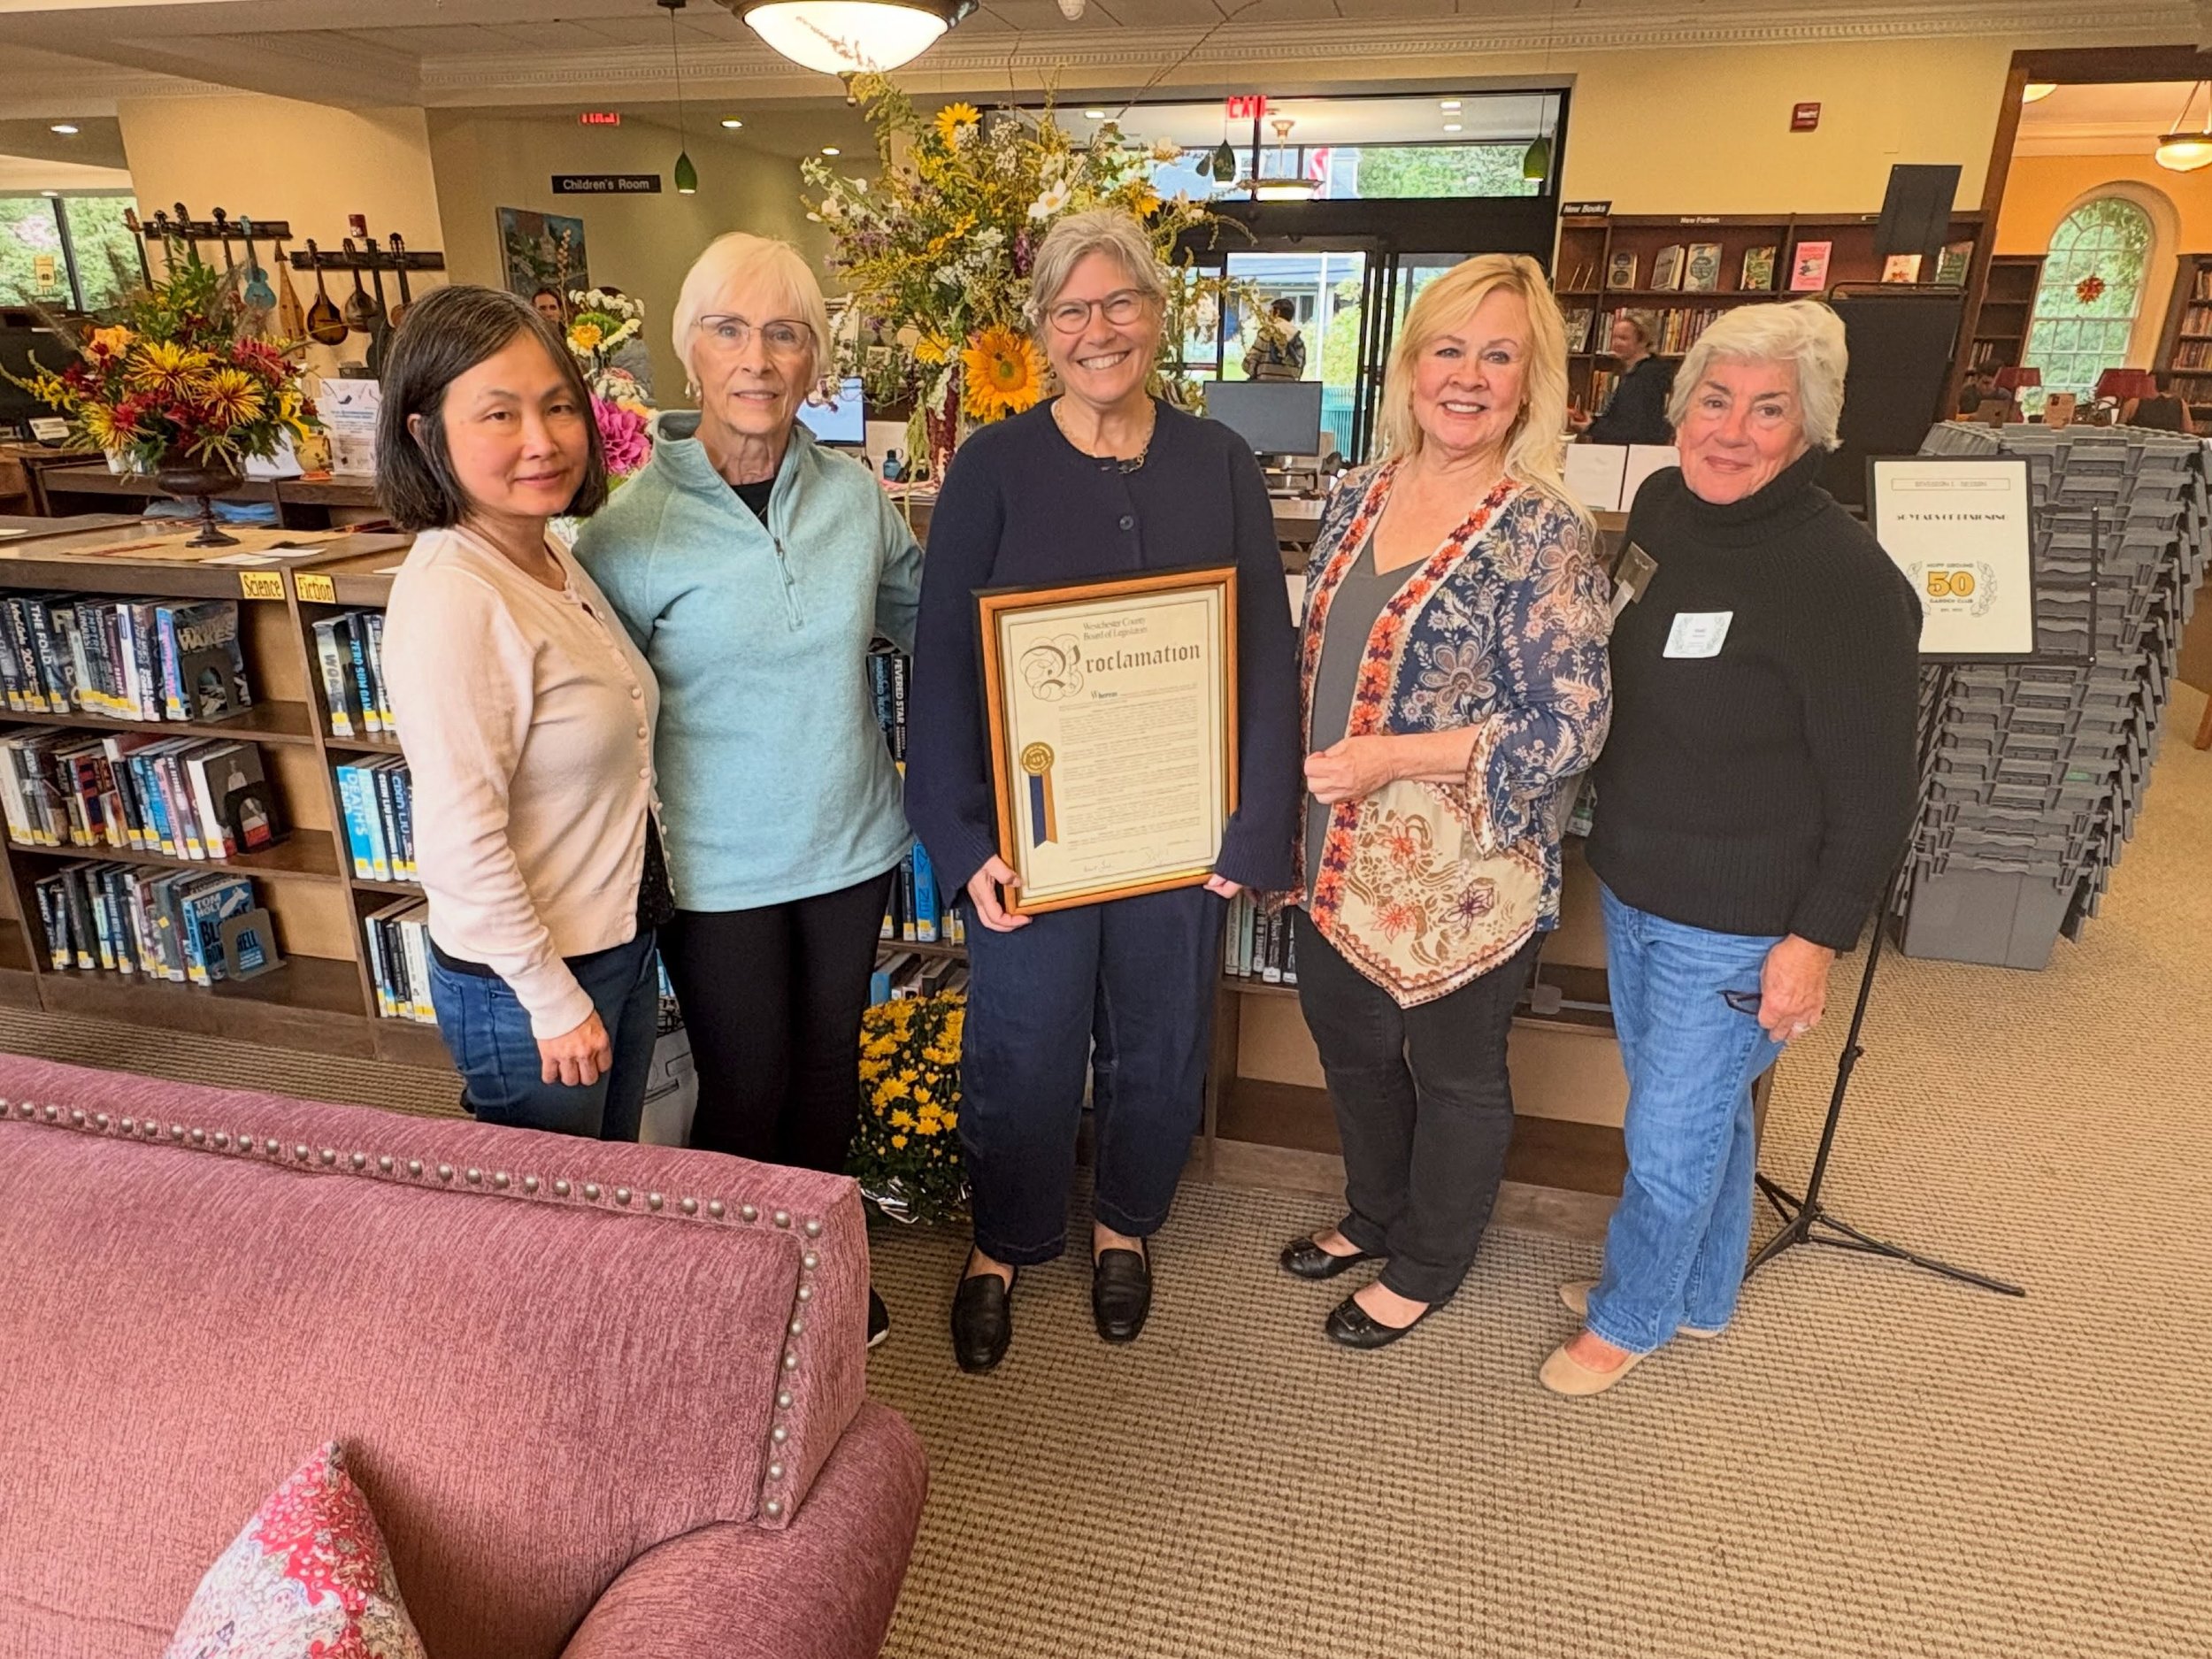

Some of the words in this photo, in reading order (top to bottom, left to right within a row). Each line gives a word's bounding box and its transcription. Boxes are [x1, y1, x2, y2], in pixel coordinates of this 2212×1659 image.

[563, 179, 614, 190] Children's
[618, 178, 649, 190] Room
[1563, 204, 1581, 213] New
[1583, 204, 1607, 213] Books
[243, 573, 281, 597] Science
[297, 576, 334, 602] Fiction
[1927, 571, 1975, 596] 50
[30, 605, 43, 630] THE
[1083, 619, 1121, 631] Westchester
[1121, 617, 1147, 627] County
[1083, 631, 1101, 641] Board
[1102, 630, 1112, 639] of
[36, 631, 52, 665] FOLD
[350, 639, 363, 665] ZERO
[355, 666, 367, 688] SUM
[894, 659, 904, 699] FEVERED
[895, 700, 904, 724] STAR
[346, 772, 368, 836] DEATH'S
[392, 775, 405, 809] CIXIN
[398, 812, 410, 834] LIU
[195, 893, 220, 907] TOM
[196, 902, 221, 918] HOLT
